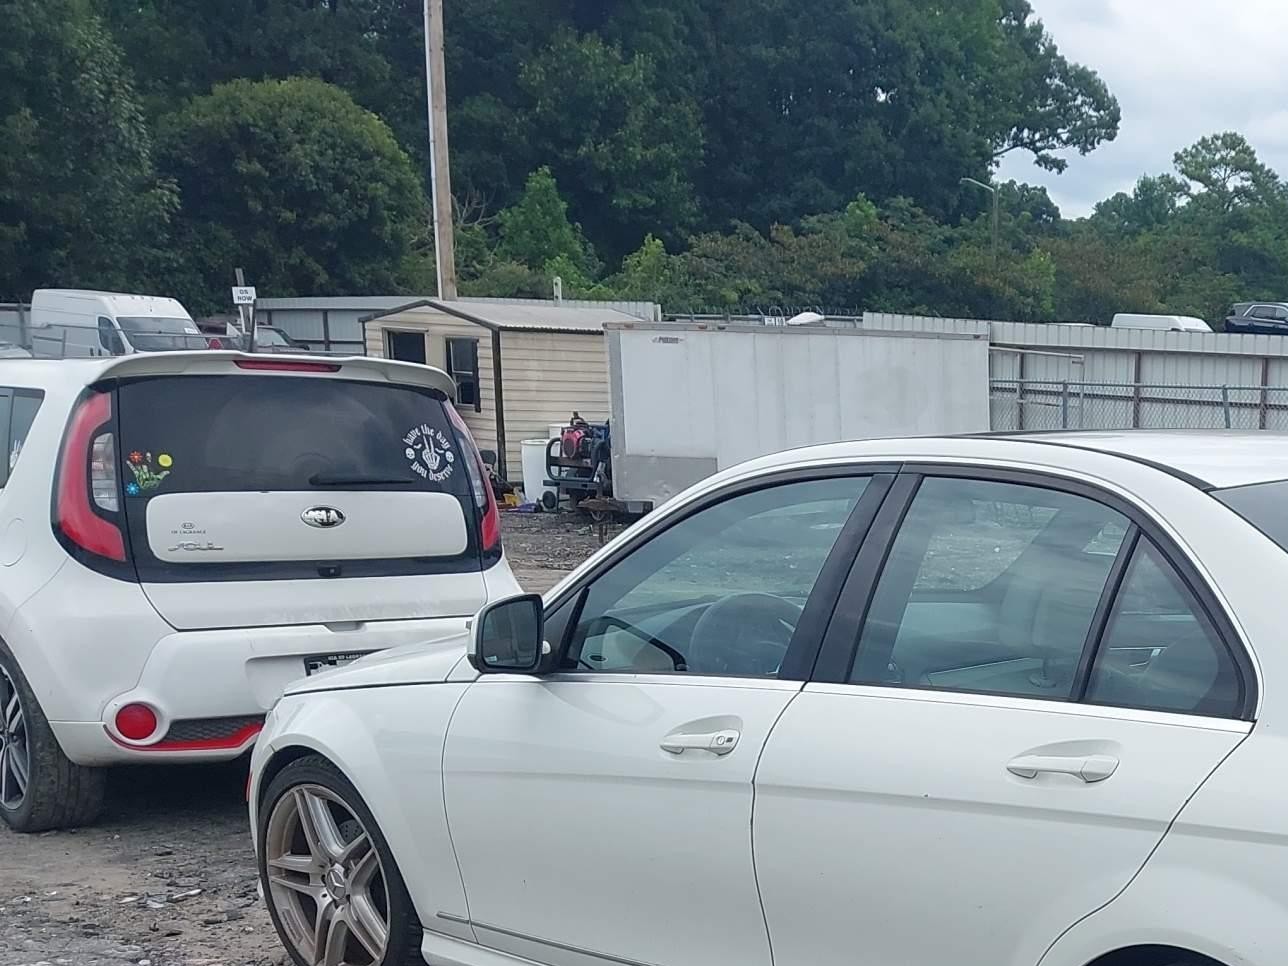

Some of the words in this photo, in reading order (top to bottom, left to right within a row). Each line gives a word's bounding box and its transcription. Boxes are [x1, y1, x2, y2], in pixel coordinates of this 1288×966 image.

[402, 427, 421, 446] have
[420, 423, 435, 436] the
[436, 431, 451, 449] day
[410, 460, 428, 478] you
[302, 508, 343, 524] KIA
